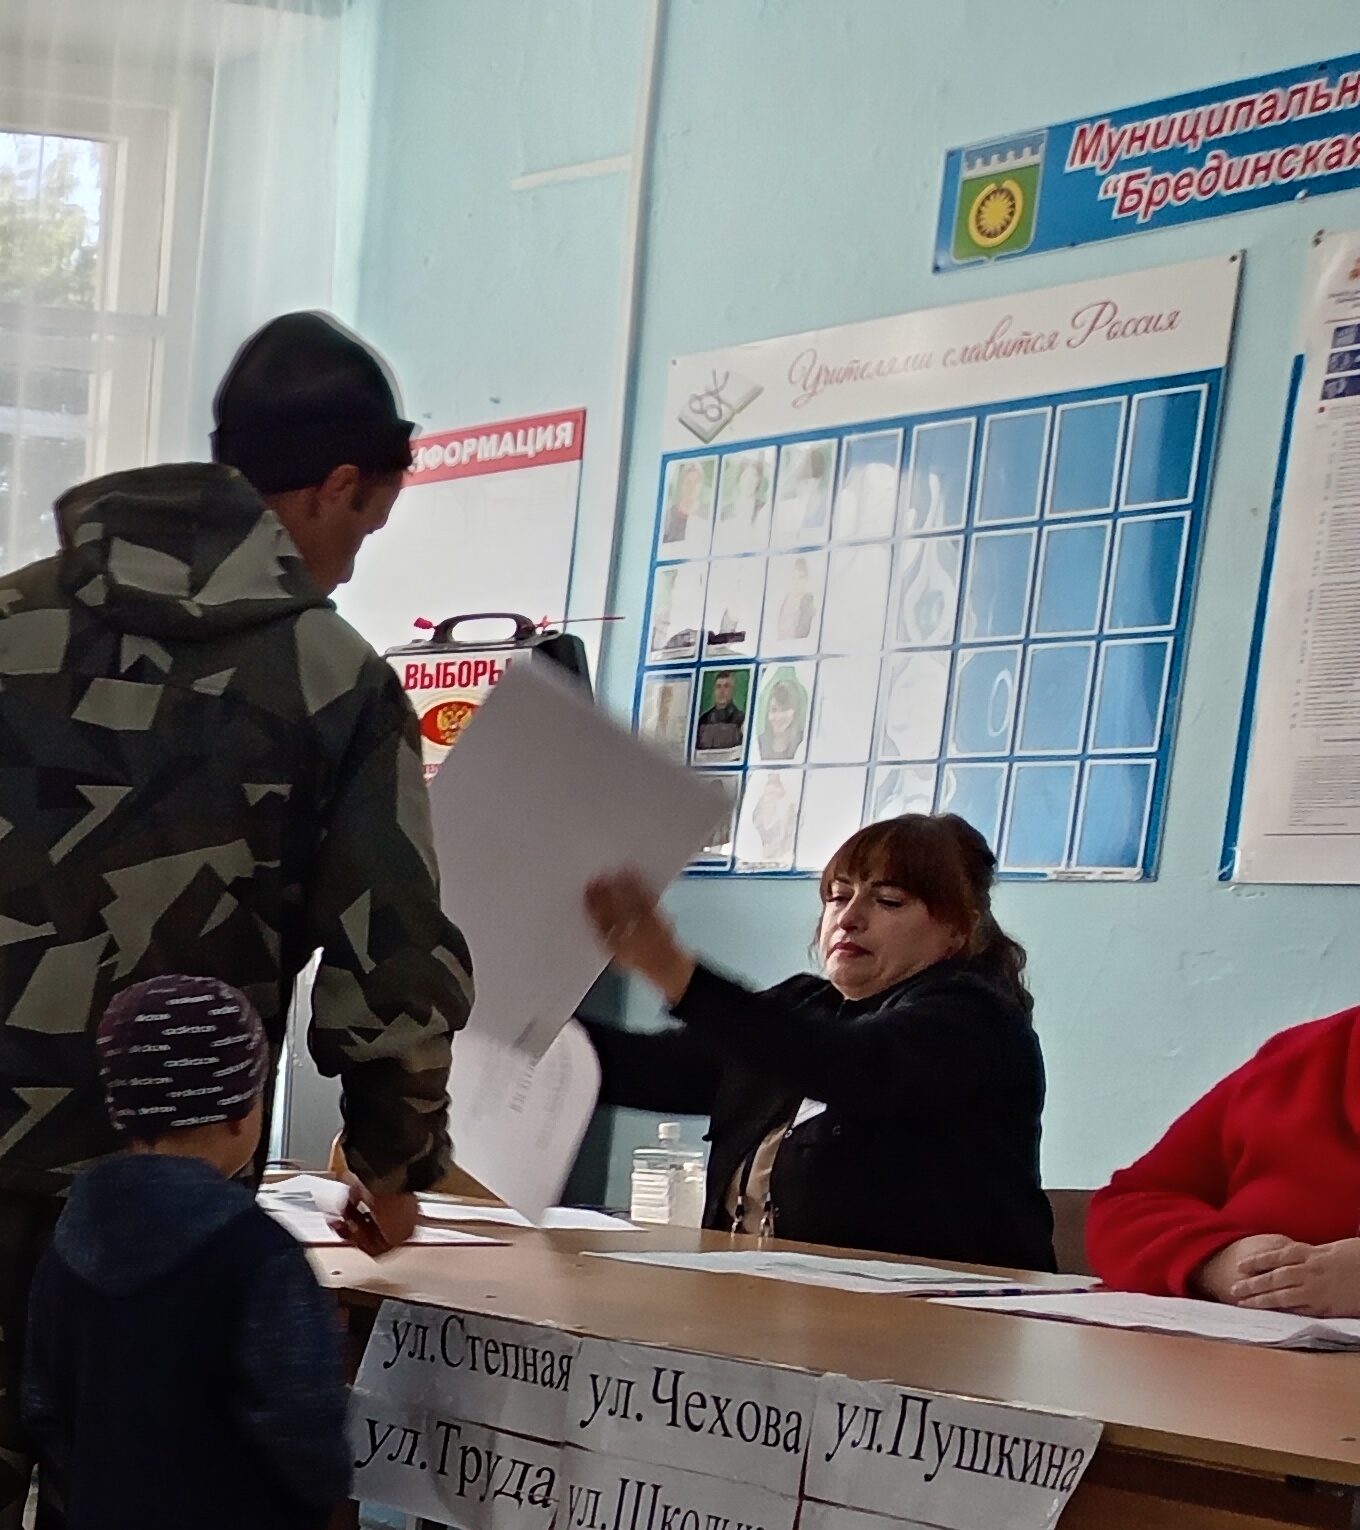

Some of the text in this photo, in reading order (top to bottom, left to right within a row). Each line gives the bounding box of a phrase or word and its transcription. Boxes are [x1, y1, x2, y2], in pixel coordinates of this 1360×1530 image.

[942, 314, 1059, 370] славится
[1066, 299, 1183, 350] Россия
[383, 1315, 573, 1391] ул.Степная
[580, 1366, 802, 1454] ул.Чехова
[825, 1394, 1085, 1493] ул.Пушкина
[354, 1418, 558, 1508] ул.Труда
